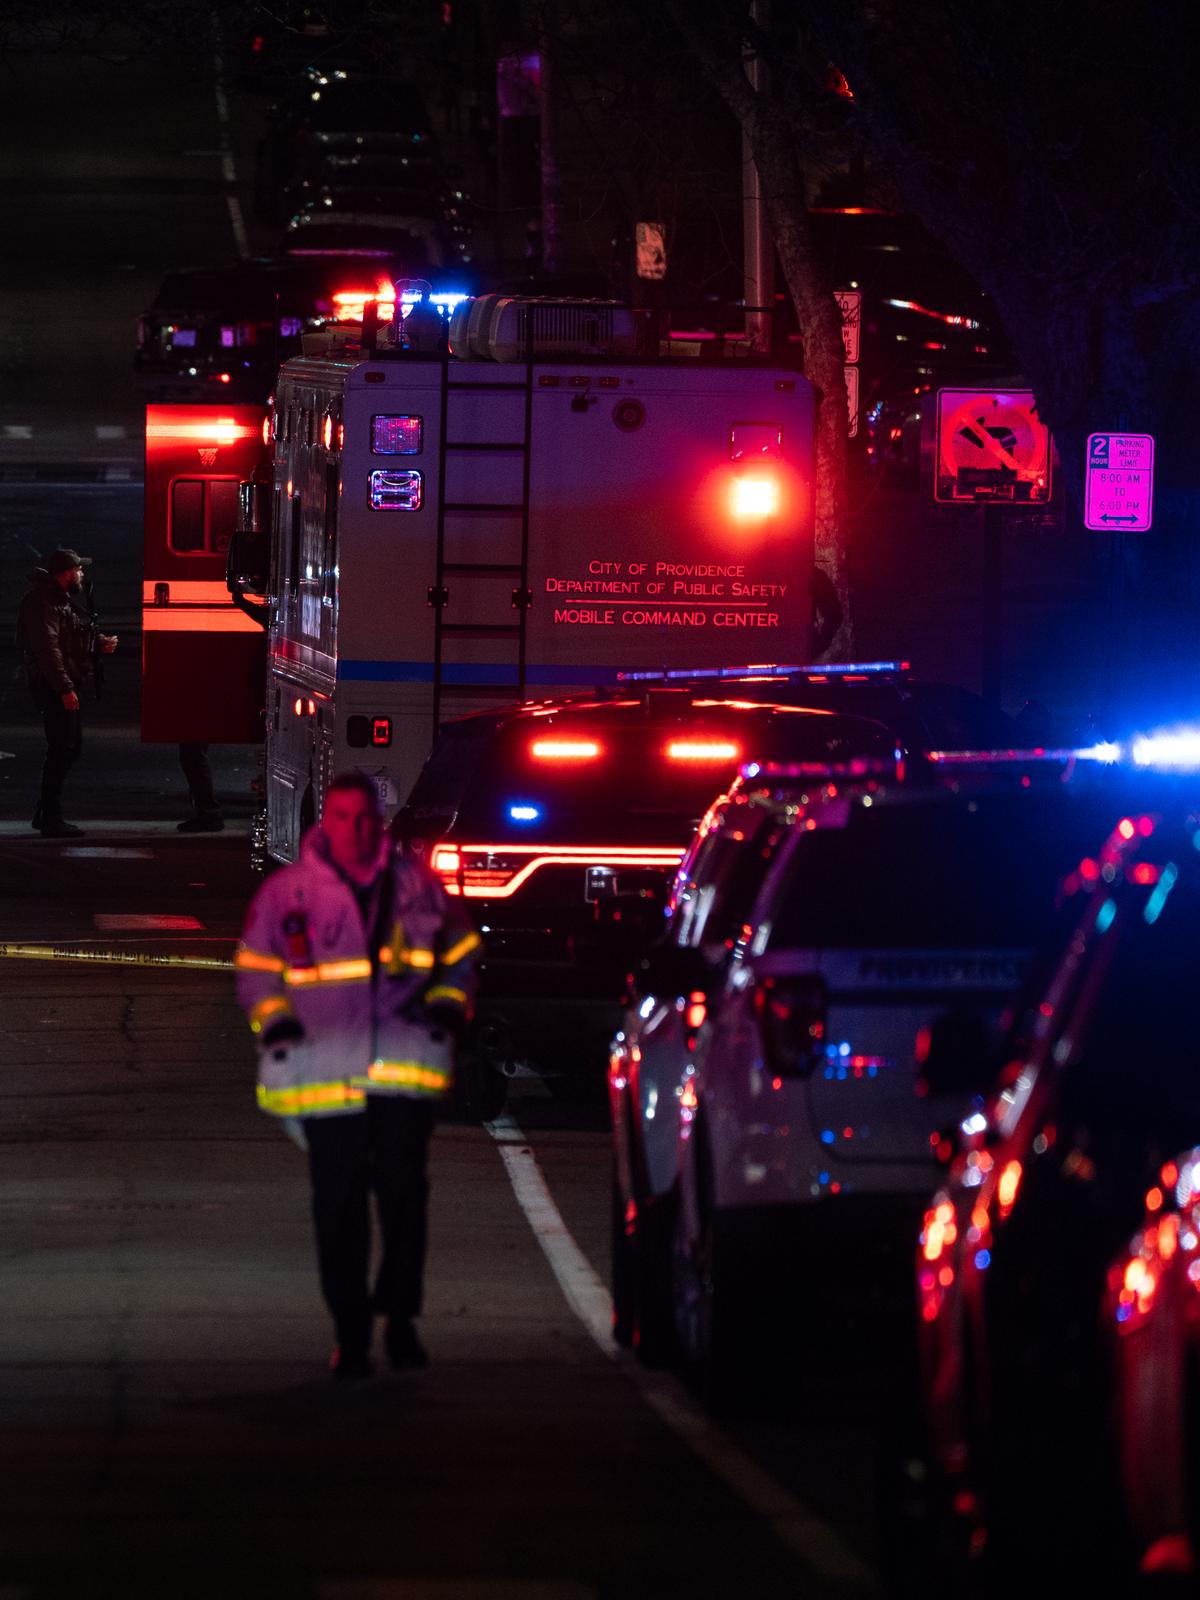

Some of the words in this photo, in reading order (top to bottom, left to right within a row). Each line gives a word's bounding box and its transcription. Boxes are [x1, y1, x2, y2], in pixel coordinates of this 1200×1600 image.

[1093, 437, 1107, 456] 2
[1090, 457, 1108, 465] HOUR
[1100, 473, 1122, 483] 8:00
[1127, 474, 1140, 484] AM
[1115, 487, 1126, 497] TO
[1126, 501, 1140, 510] PM
[588, 560, 622, 575] CITY
[628, 563, 648, 575] OF
[655, 562, 745, 577] PROVIDENCE
[545, 578, 641, 594] DEPARTMENT
[646, 582, 666, 594] OF
[673, 581, 725, 596] PUBLIC
[731, 582, 788, 597] SAFETY
[554, 609, 615, 625] MOBILE
[622, 611, 706, 626] COMMAND
[713, 612, 779, 627] CENTER
